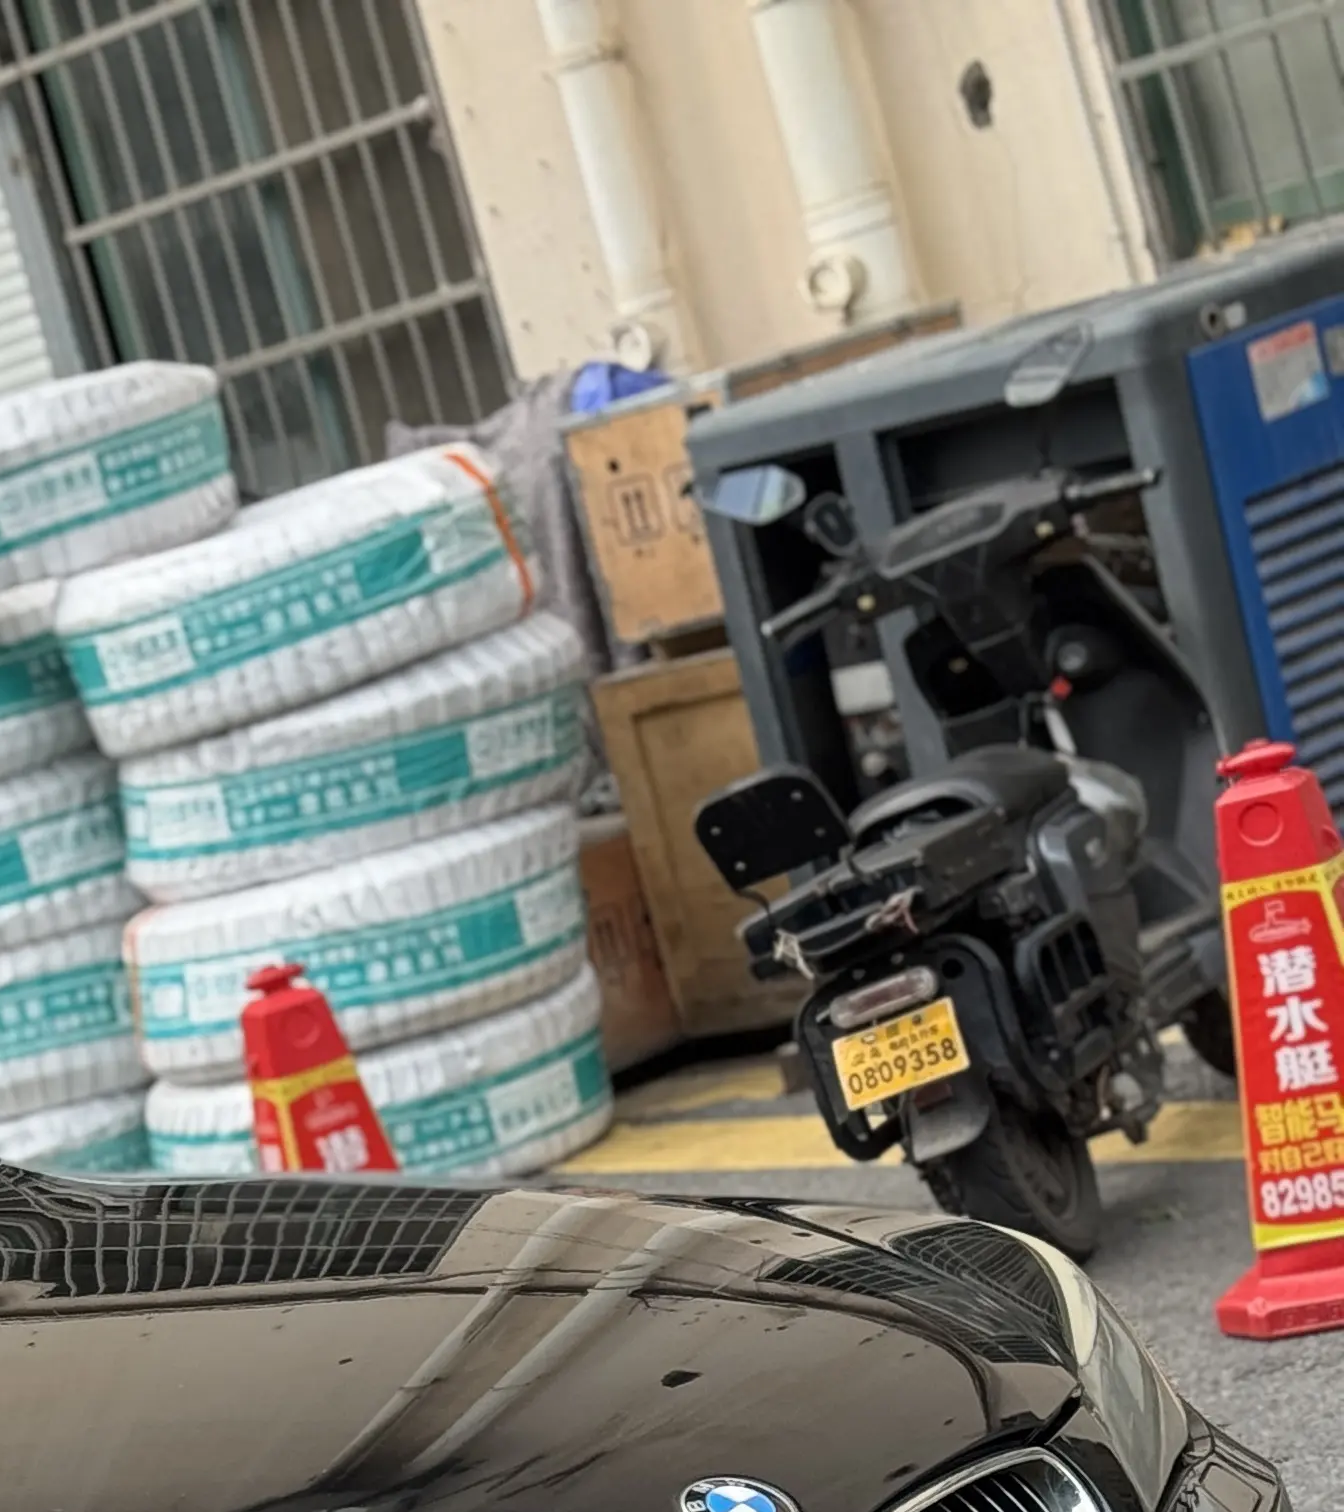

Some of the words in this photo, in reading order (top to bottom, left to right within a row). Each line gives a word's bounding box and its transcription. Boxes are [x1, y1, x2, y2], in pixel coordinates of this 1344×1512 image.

[848, 1037, 958, 1095] 0809358
[1256, 944, 1338, 1093] 潜水艇
